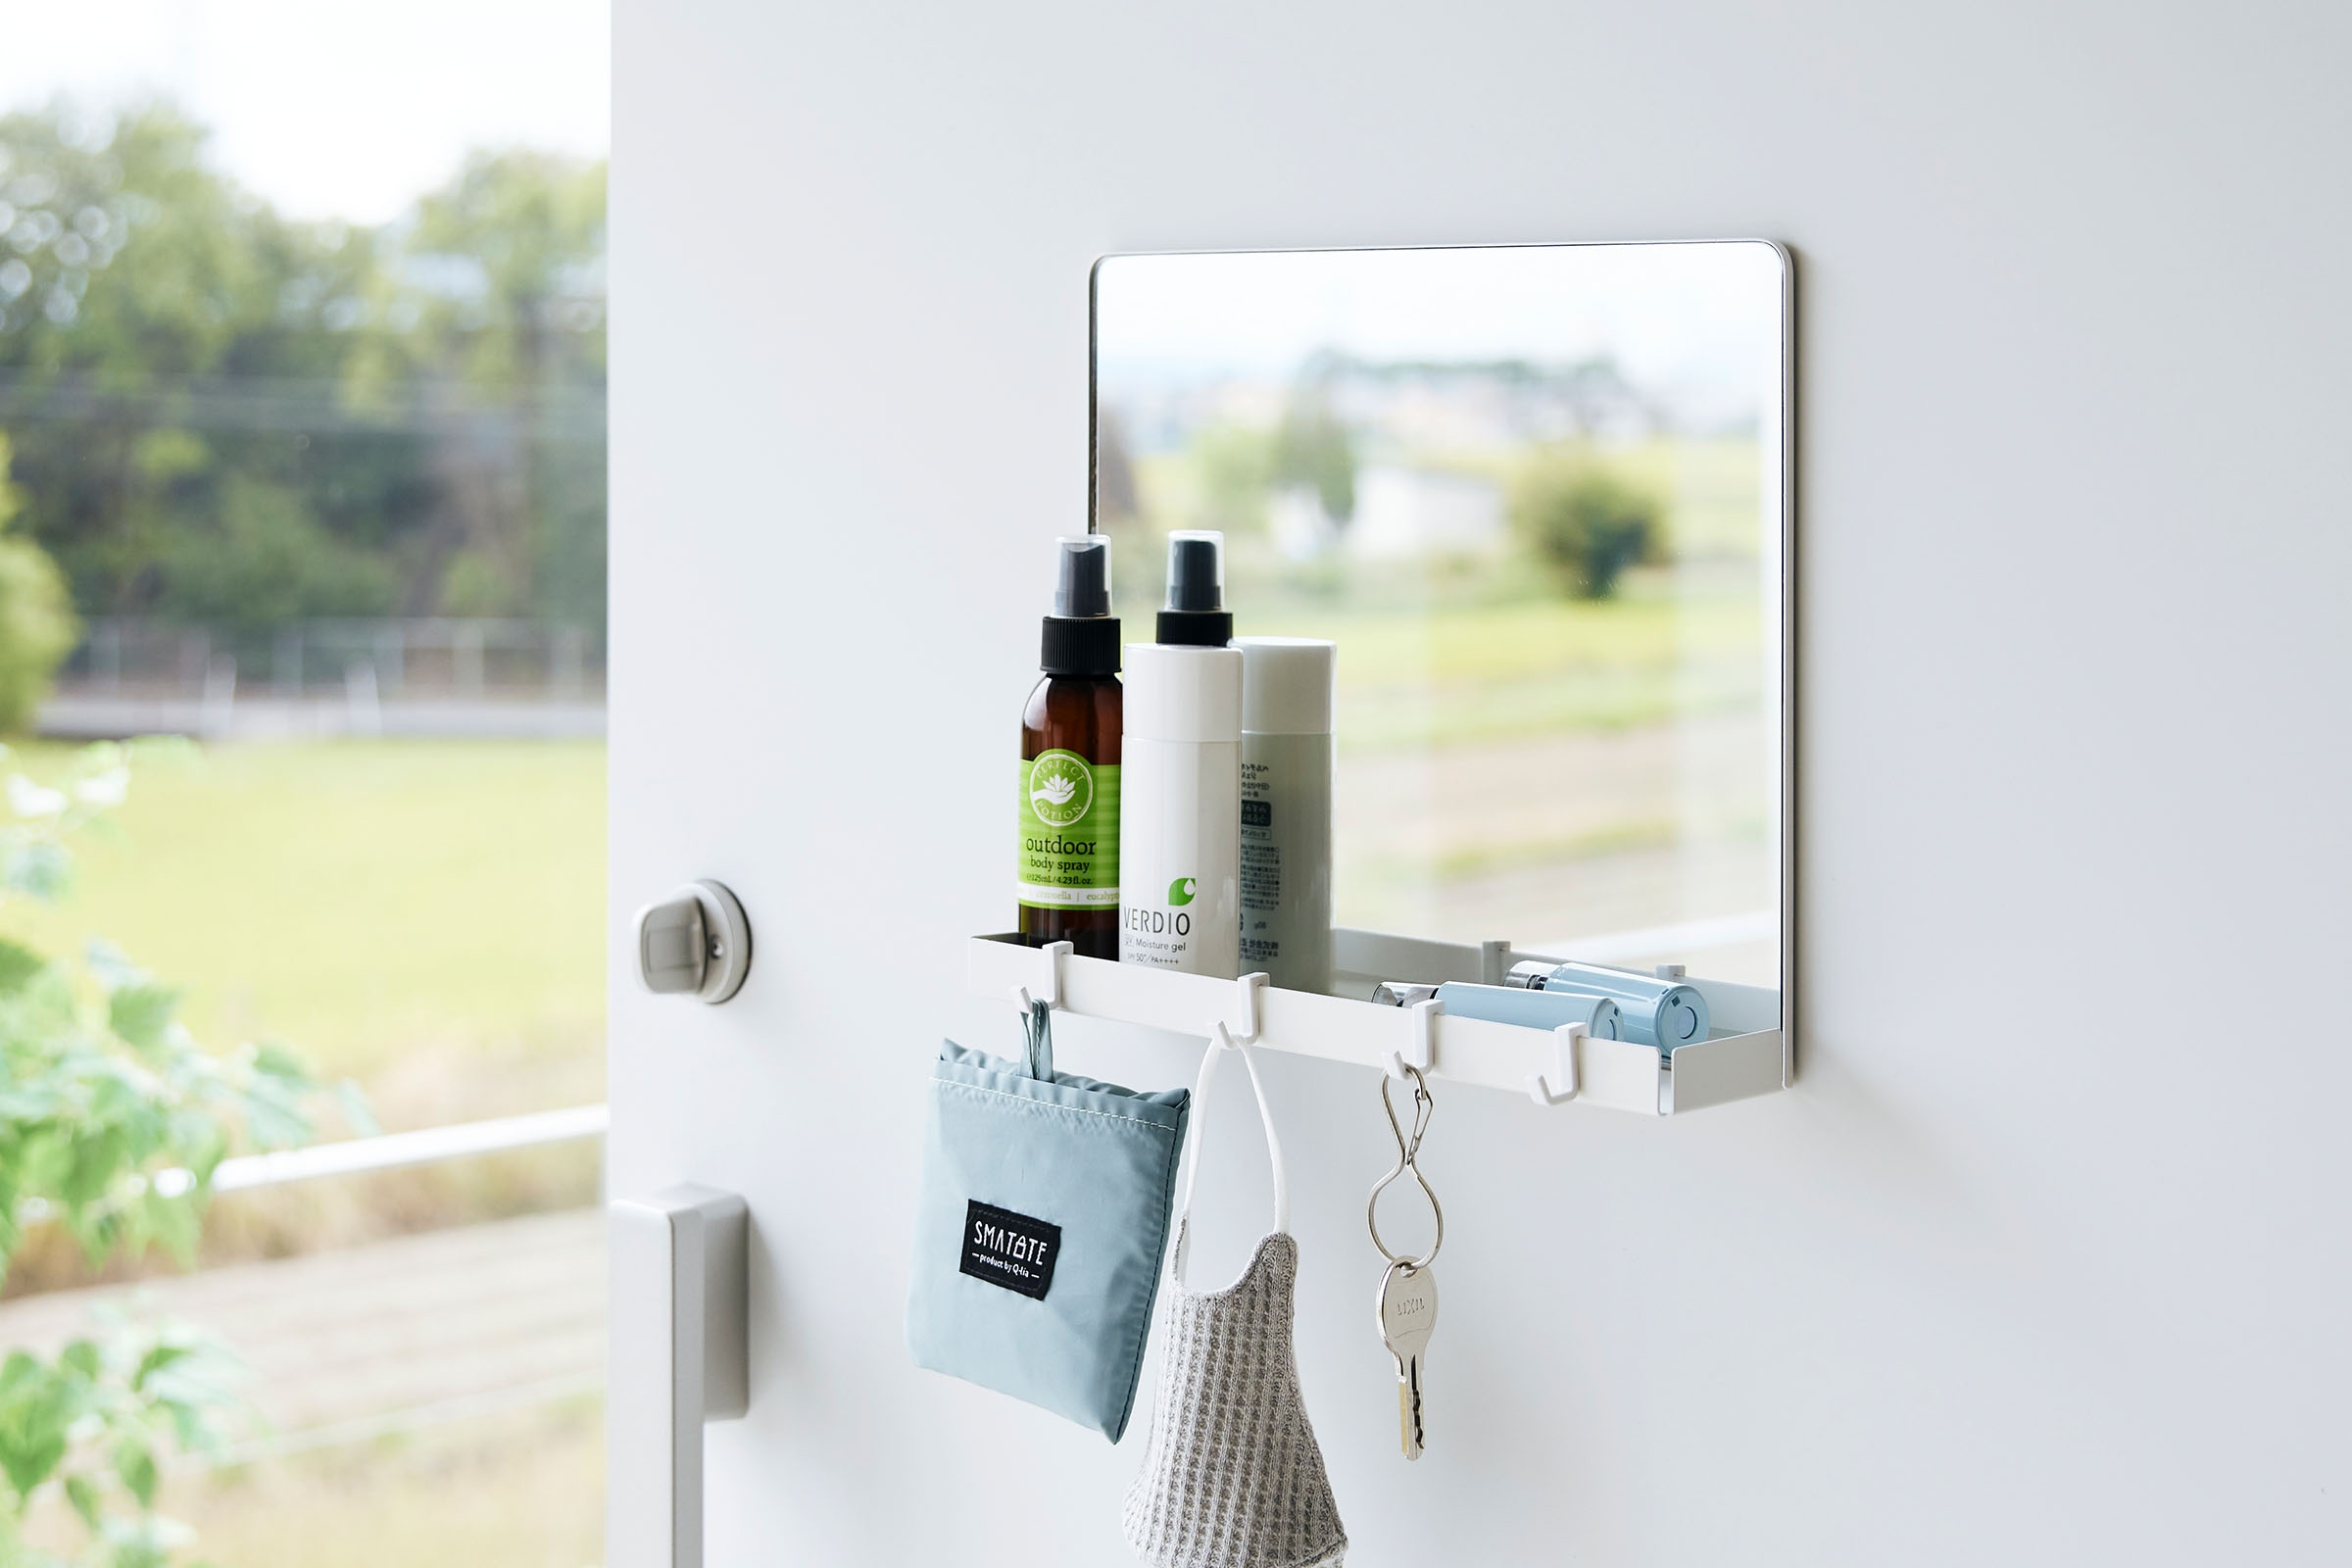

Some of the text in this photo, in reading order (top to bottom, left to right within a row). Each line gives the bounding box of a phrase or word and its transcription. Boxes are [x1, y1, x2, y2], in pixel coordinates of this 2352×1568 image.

[1036, 760, 1086, 781] PERFECT
[1036, 801, 1082, 820] POTION
[1026, 835, 1097, 855] outdoor
[1030, 855, 1090, 873] body spray
[1124, 906, 1190, 936] VERDIO
[1136, 938, 1169, 951] Moisture
[1171, 942, 1186, 953] gel
[980, 1254, 1004, 1269] product
[1004, 1260, 1012, 1273] by
[1396, 1298, 1425, 1316] LIXIL
